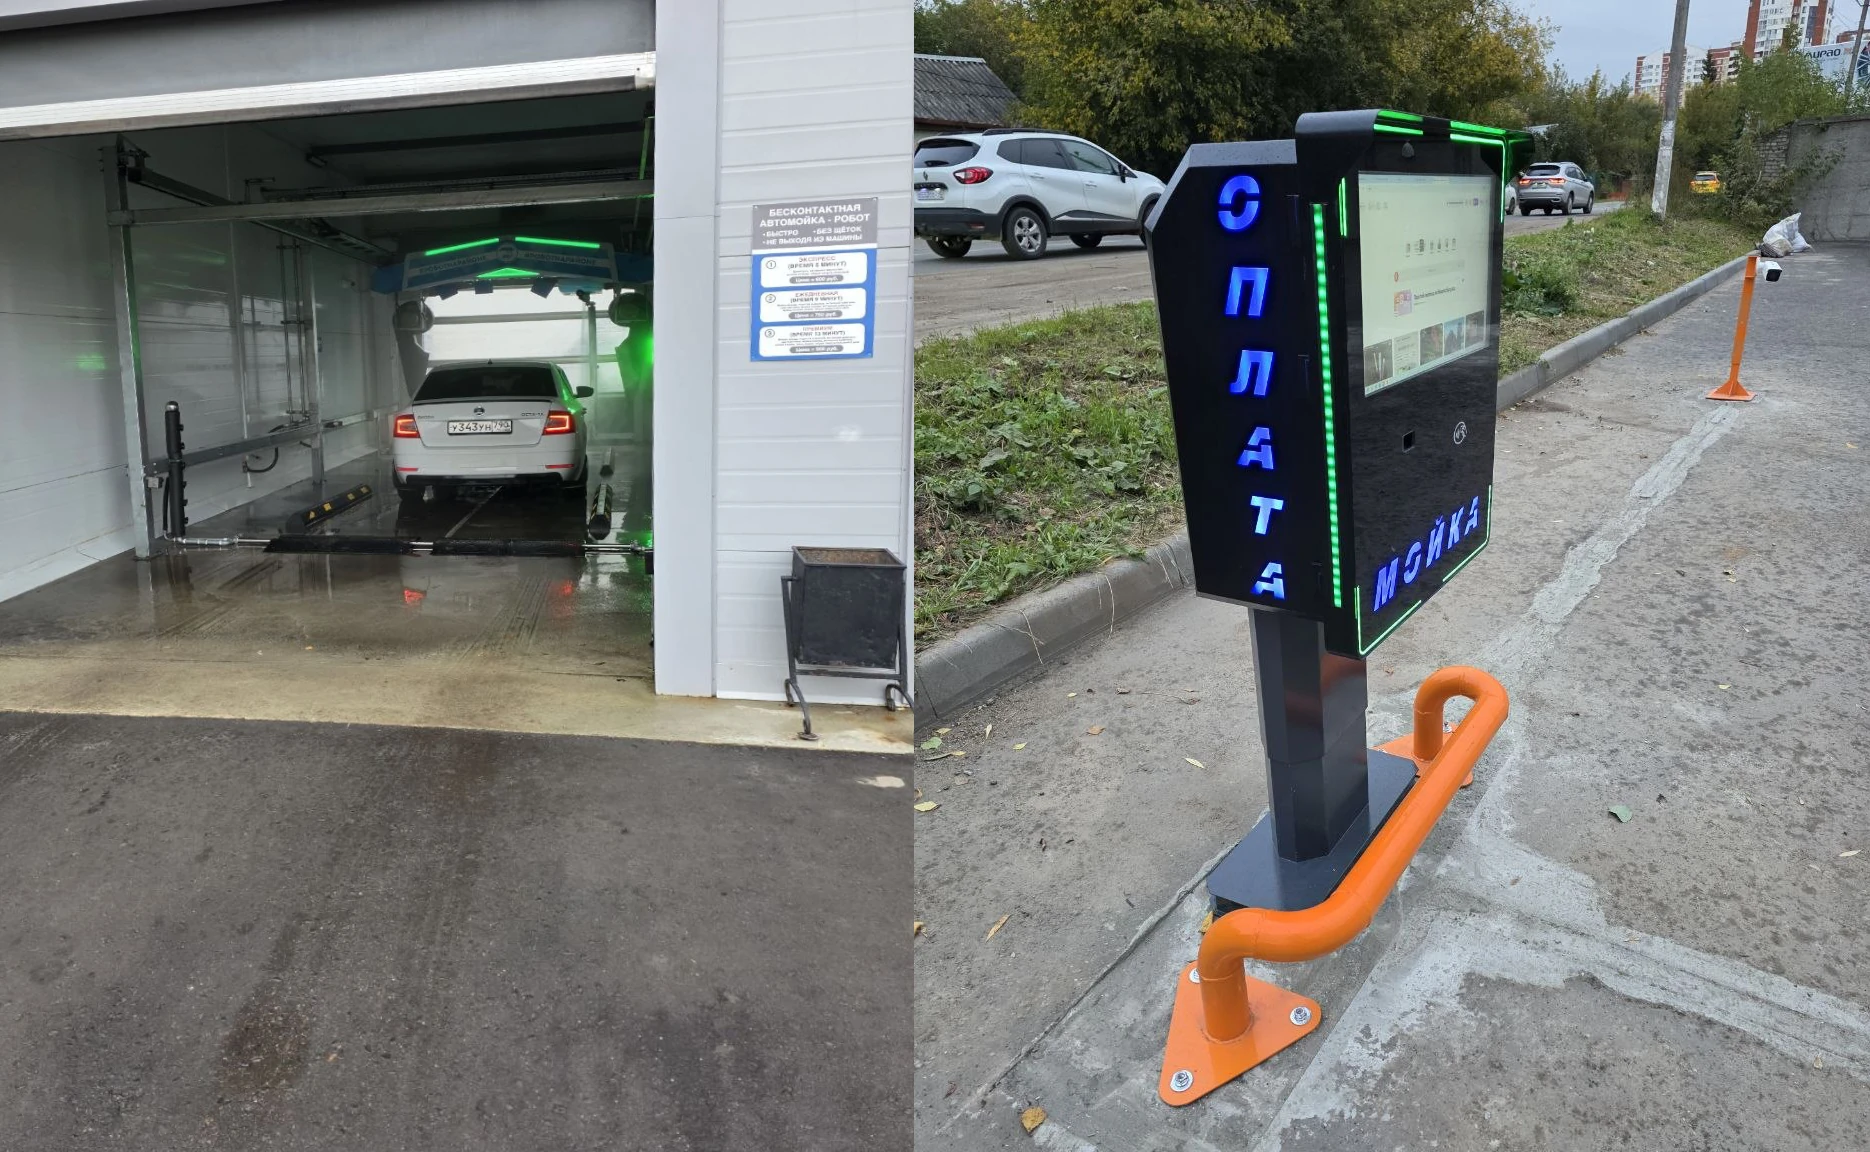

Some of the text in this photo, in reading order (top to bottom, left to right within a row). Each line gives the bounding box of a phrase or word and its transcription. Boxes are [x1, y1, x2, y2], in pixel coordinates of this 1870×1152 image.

[769, 204, 861, 217] БЕСКОНТАКТНАЯ
[760, 215, 825, 227] АВТОМОЙКА
[834, 213, 870, 223] РОБОТ
[778, 236, 813, 245] ВЫХОДЯ
[813, 235, 824, 243] ИЗ
[825, 234, 862, 242] МАШИНЫ
[1218, 175, 1286, 600] ОПЛАТА
[1373, 496, 1479, 612] МОЙКА
